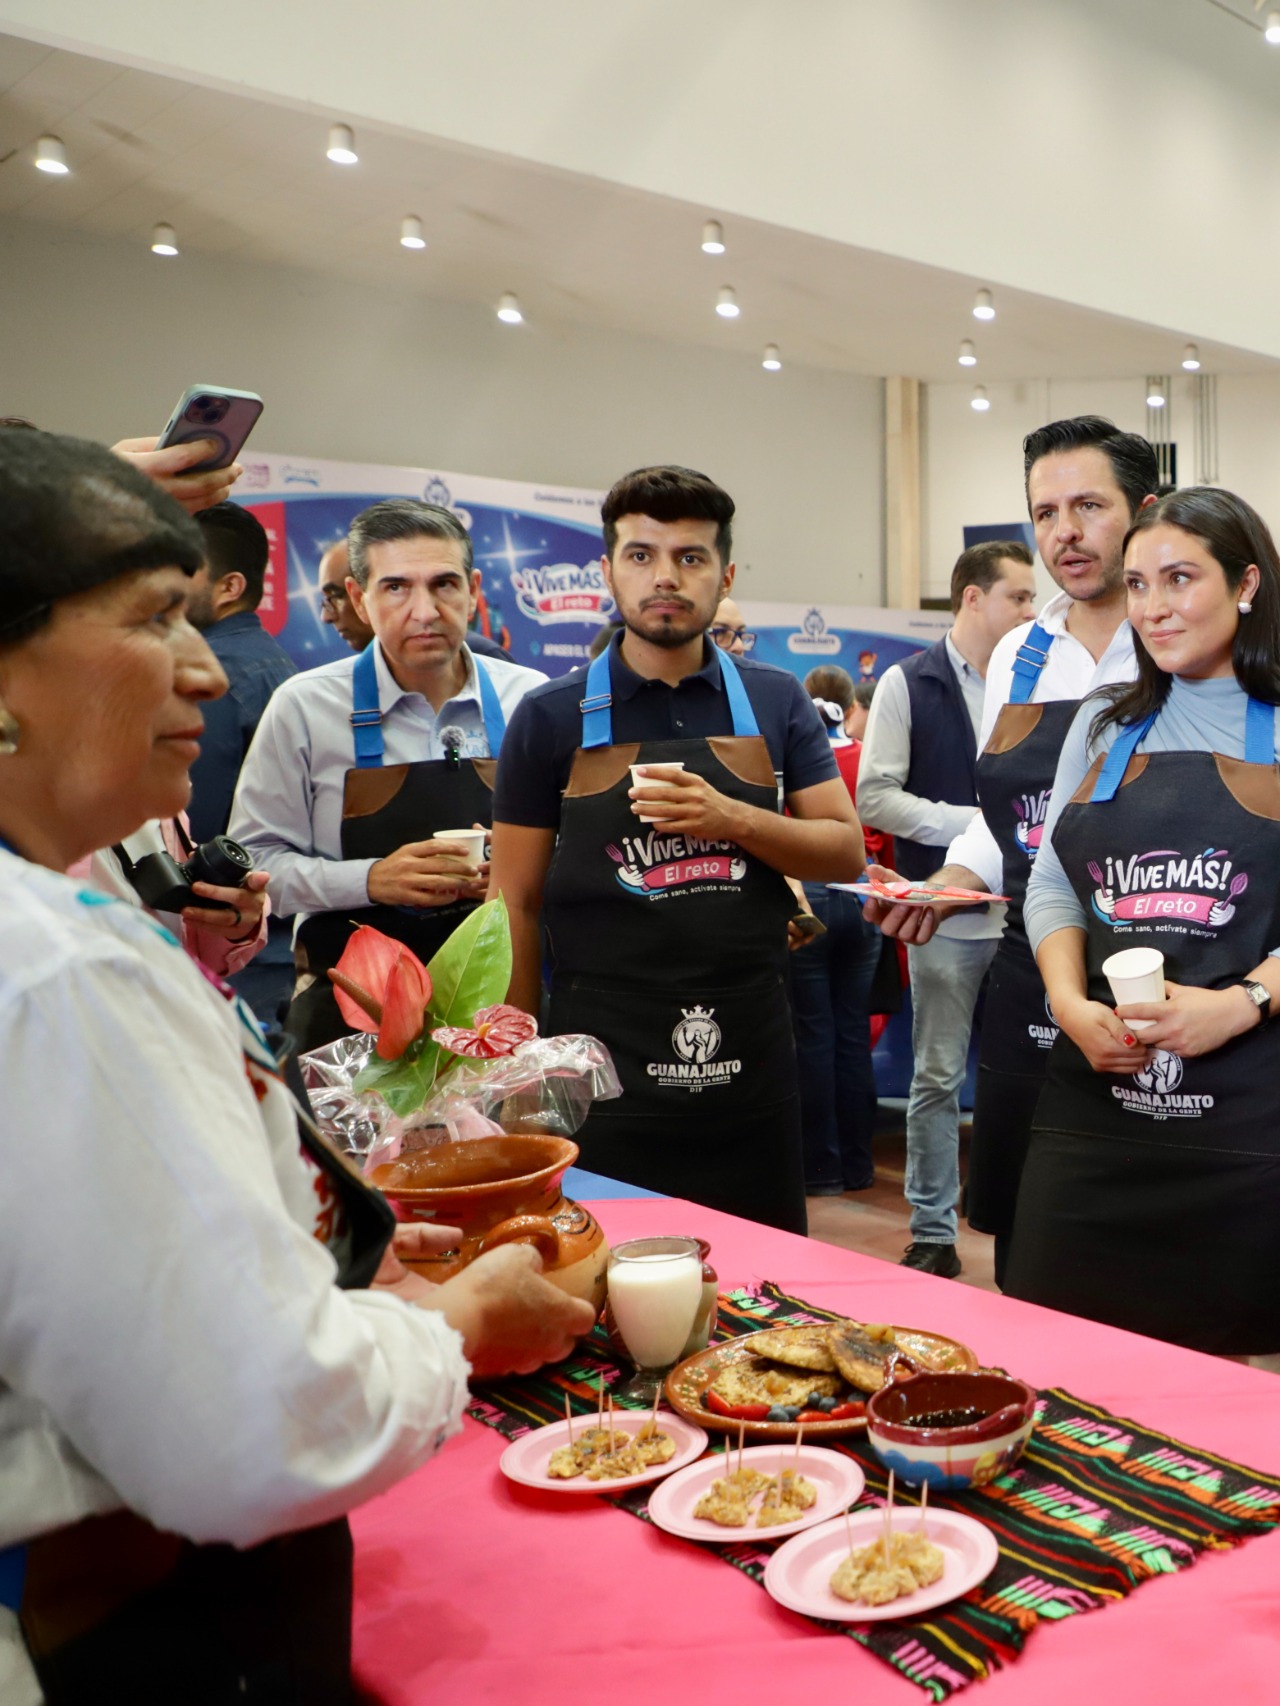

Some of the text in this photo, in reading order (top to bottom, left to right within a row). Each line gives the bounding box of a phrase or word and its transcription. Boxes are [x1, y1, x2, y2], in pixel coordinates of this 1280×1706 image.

[1021, 790, 1047, 825] ¡VI
[664, 861, 720, 883] El reto
[649, 892, 669, 901] Come
[1133, 898, 1197, 915] El reto
[1113, 925, 1133, 933] Come
[1190, 927, 1218, 939] siempre
[646, 1059, 742, 1079] GUANAJUATO
[658, 1077, 692, 1085] GOBIERNO
[1111, 1085, 1214, 1109] GUANAJUATO
[1122, 1101, 1157, 1112] GOBIERNO
